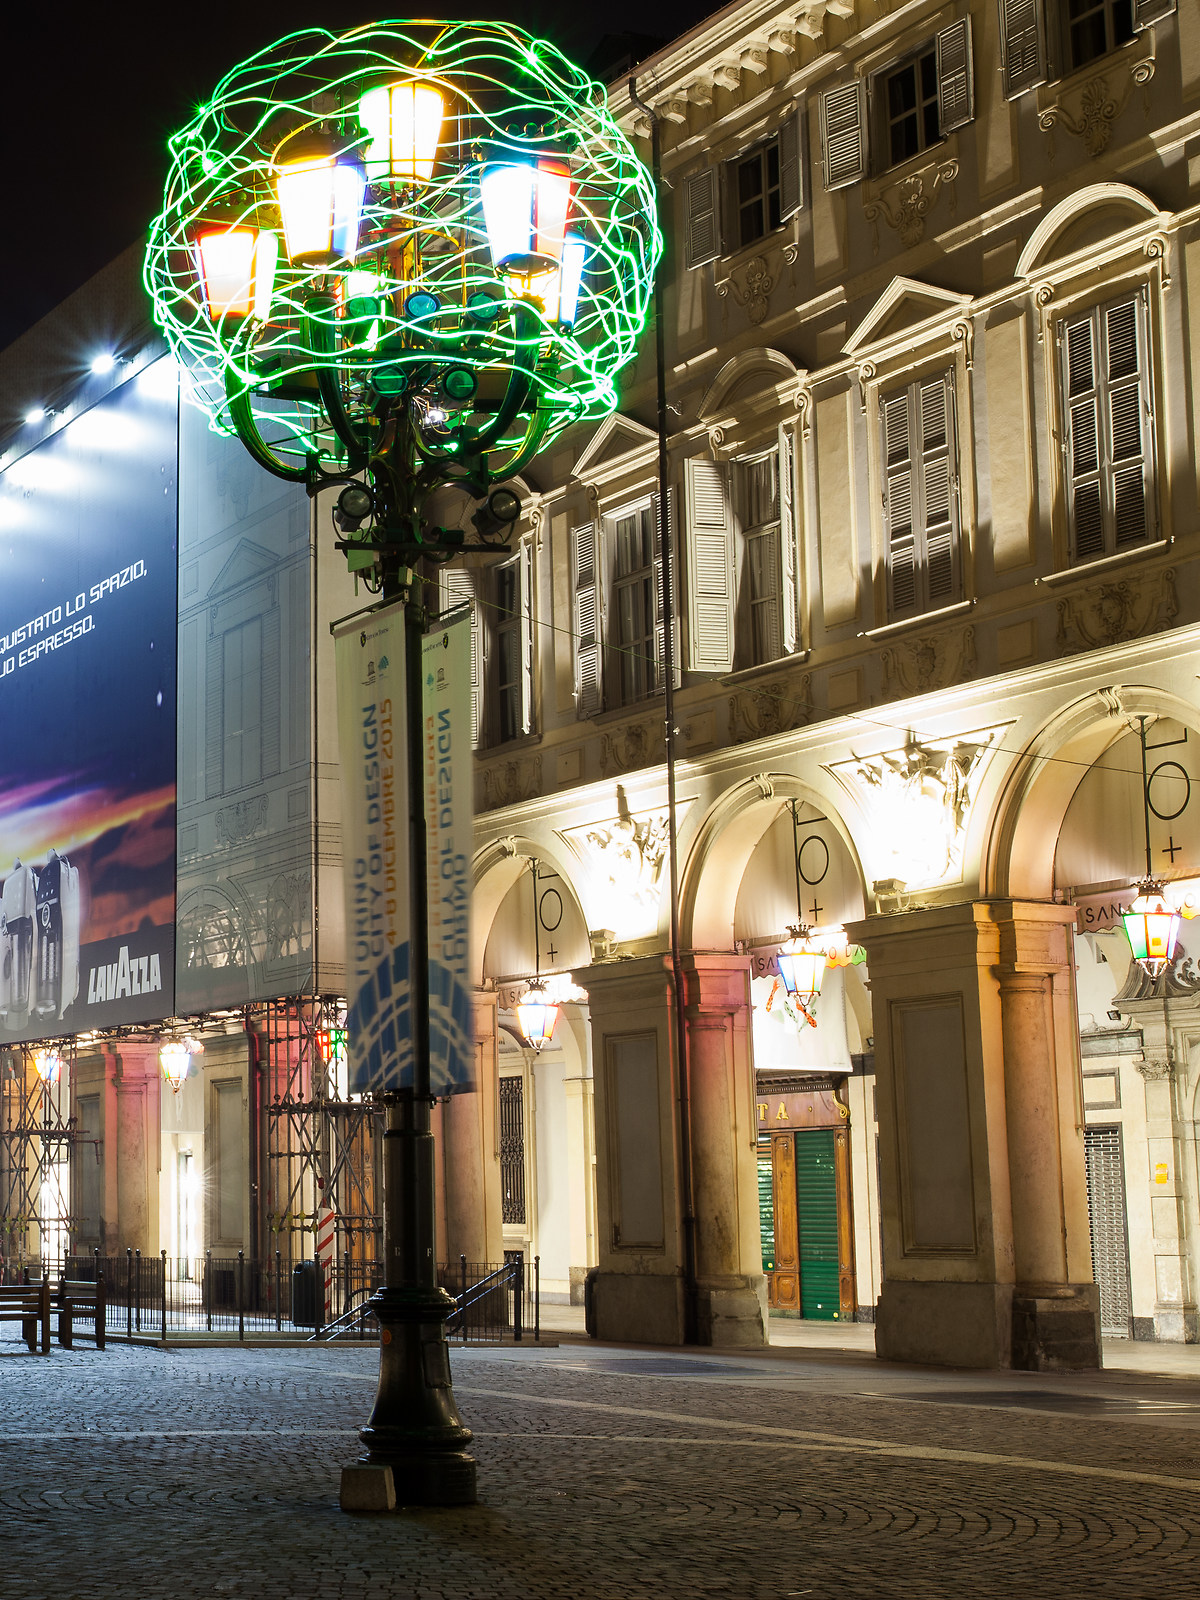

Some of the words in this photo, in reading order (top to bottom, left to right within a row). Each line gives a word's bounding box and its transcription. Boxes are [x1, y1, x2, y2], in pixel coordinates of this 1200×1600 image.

[66, 593, 85, 617] LO
[89, 560, 148, 604] SPAZIO,
[18, 615, 96, 668] ESPRESSO.
[380, 698, 394, 761] 2015
[362, 703, 382, 825] DESIGN
[368, 833, 383, 875] OF
[382, 765, 397, 893] DICEMBRE
[370, 886, 385, 957] CITY
[87, 945, 162, 1005] LAVAZZA
